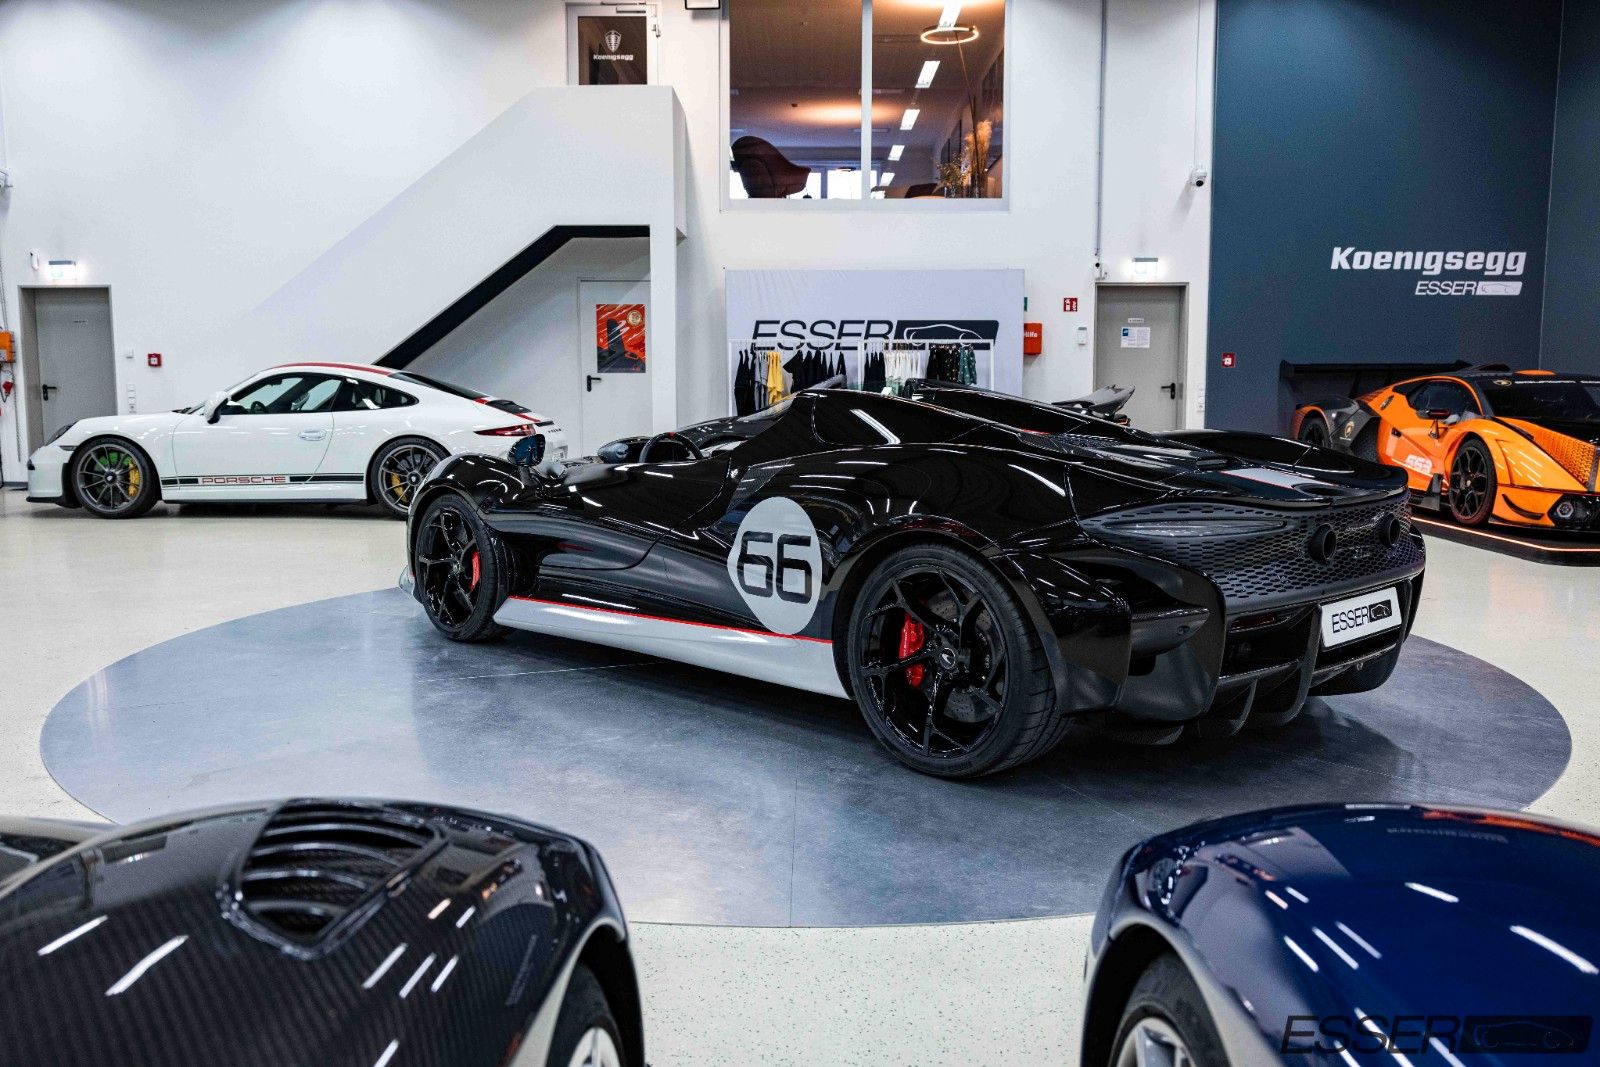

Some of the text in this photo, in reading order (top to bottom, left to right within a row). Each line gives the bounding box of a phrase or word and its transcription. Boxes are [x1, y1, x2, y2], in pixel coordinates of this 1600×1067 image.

[1330, 246, 1527, 276] Koenigsegg
[1415, 281, 1477, 296] ESSER
[752, 319, 894, 350] ESSER
[202, 476, 286, 484] PORSCHE
[737, 530, 813, 605] 66
[1332, 605, 1370, 634] ESSER
